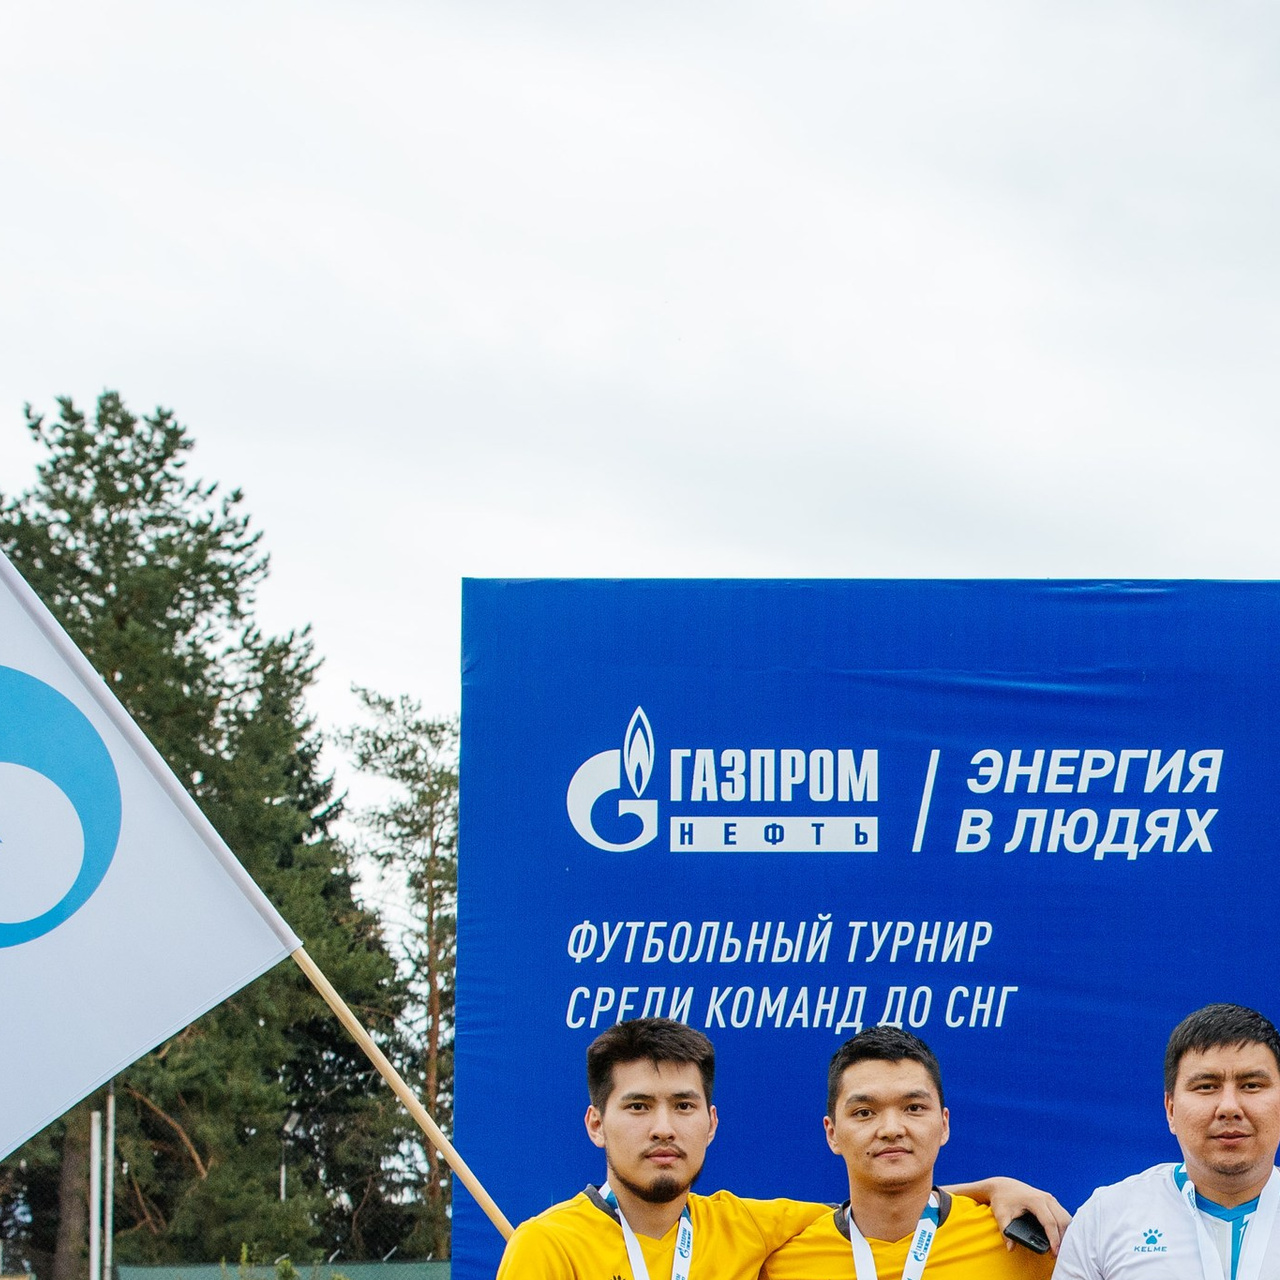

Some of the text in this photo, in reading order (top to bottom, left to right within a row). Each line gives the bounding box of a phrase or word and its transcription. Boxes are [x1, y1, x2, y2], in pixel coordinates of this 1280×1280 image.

[670, 749, 878, 802] ГАЗПРОМ
[966, 749, 1224, 794] ЭНЕРГИЯ
[678, 822, 869, 846] НЕФТЬ
[955, 808, 1219, 861] В ЛЮДЯХ
[566, 913, 993, 964] ФУТБОЛЬНЫЙ ТУРНИР
[565, 985, 1019, 1035] СРЕДИ КОМАНД ДО СНГ
[1133, 1245, 1168, 1253] KELME
